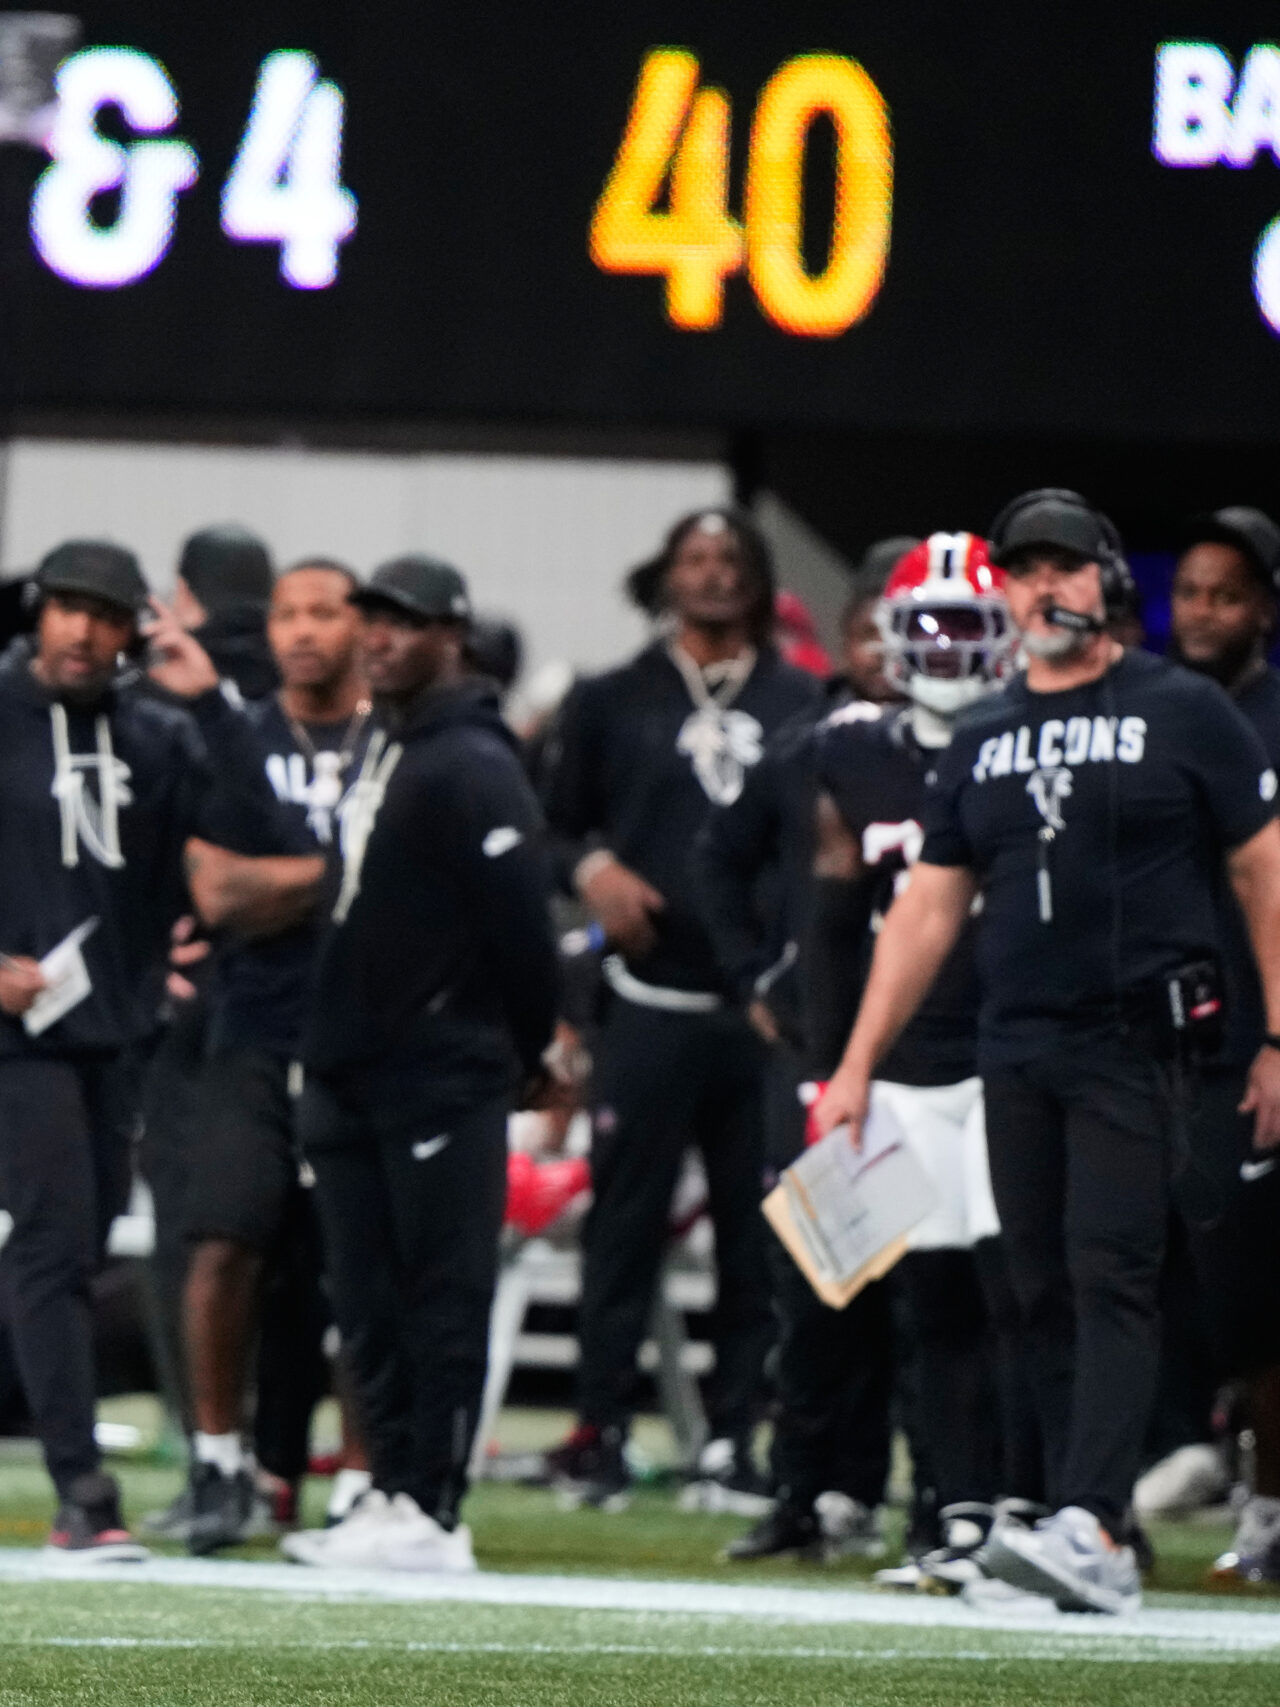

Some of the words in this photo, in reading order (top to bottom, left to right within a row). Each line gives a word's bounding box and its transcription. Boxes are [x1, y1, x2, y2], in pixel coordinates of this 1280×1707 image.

[31, 45, 200, 288] &
[220, 48, 358, 289] 4
[590, 48, 894, 338] 40
[972, 715, 1147, 783] FALCONS
